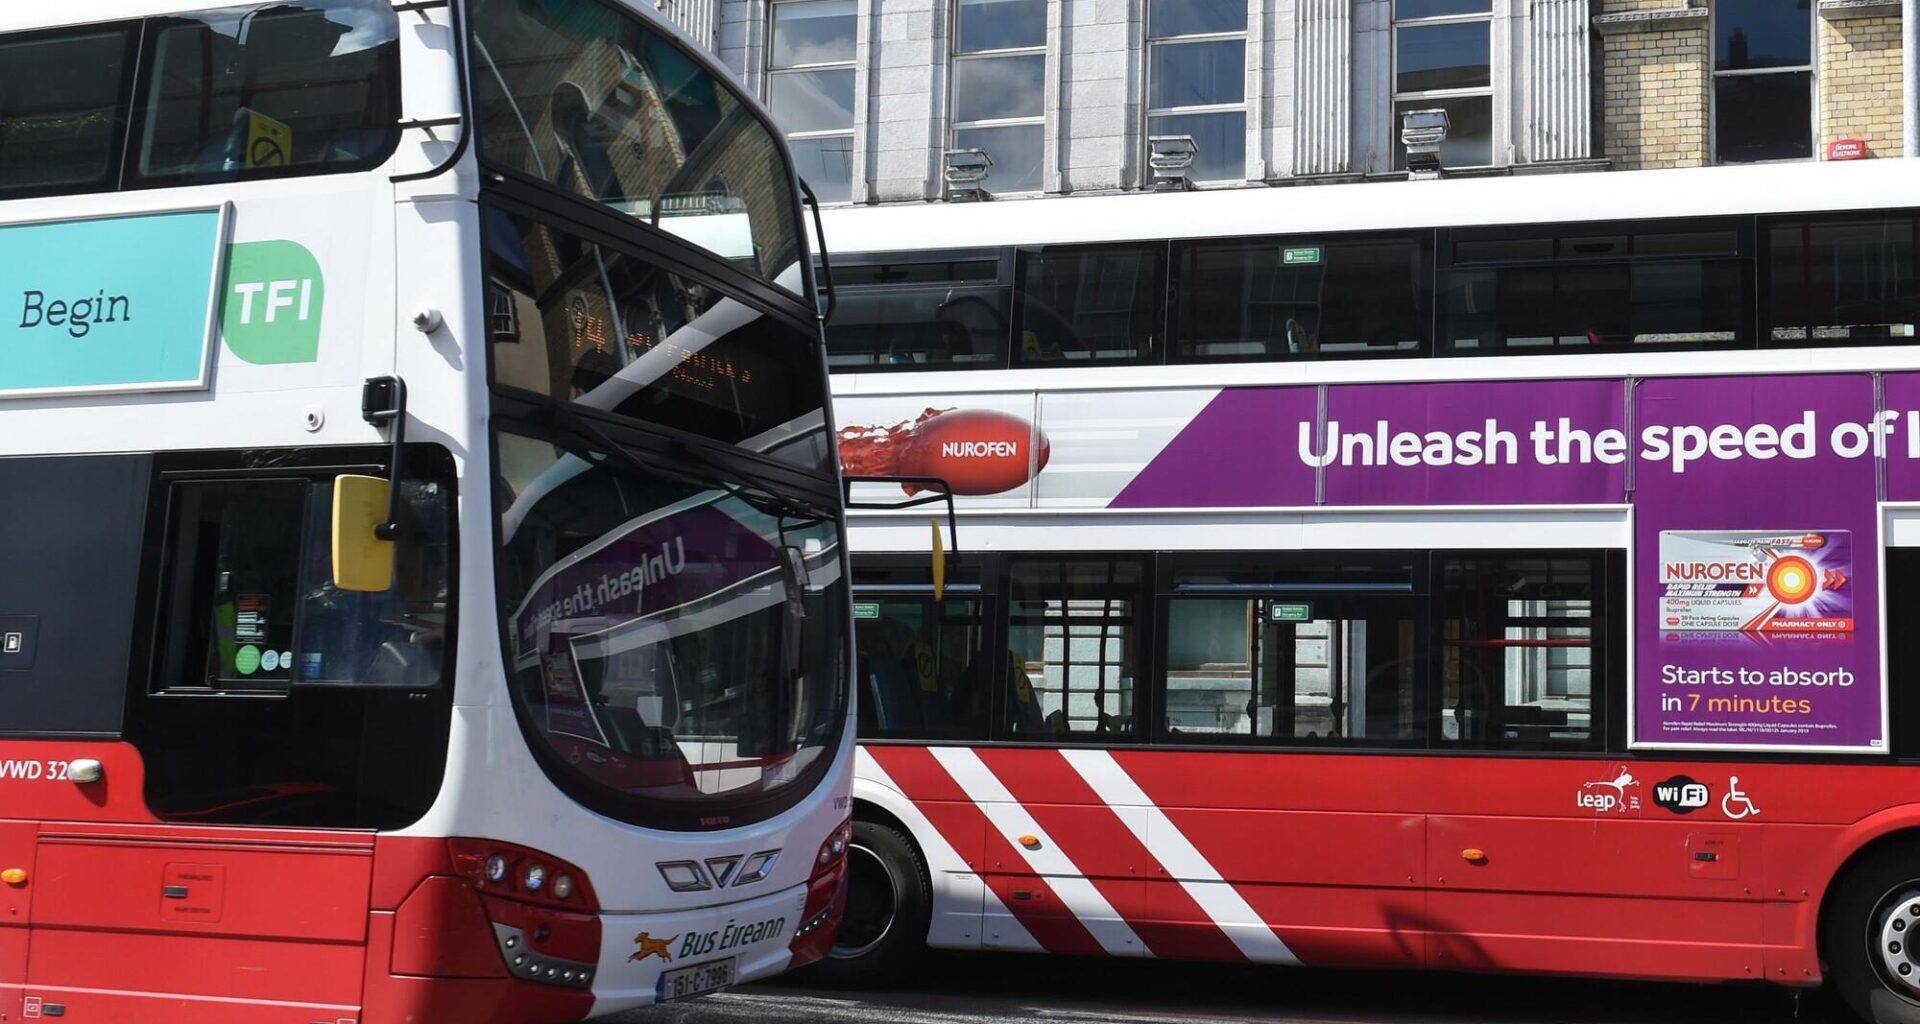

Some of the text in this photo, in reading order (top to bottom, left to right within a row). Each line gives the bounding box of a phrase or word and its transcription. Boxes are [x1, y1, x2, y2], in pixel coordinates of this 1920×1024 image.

[234, 279, 312, 324] TFI
[19, 289, 130, 338] Begin
[942, 441, 1017, 458] NUROFEN
[1299, 418, 1517, 467] Unleash
[1530, 417, 1627, 466] the
[1640, 410, 1816, 472] speed
[1830, 410, 1900, 459] of
[1666, 563, 1763, 580] NUROFEN
[1662, 664, 1854, 686] Starts to absorb
[1662, 693, 1811, 714] in 7 minutes
[0, 760, 68, 780] VWD 32
[1577, 790, 1616, 811] leap
[678, 931, 719, 959] Bus
